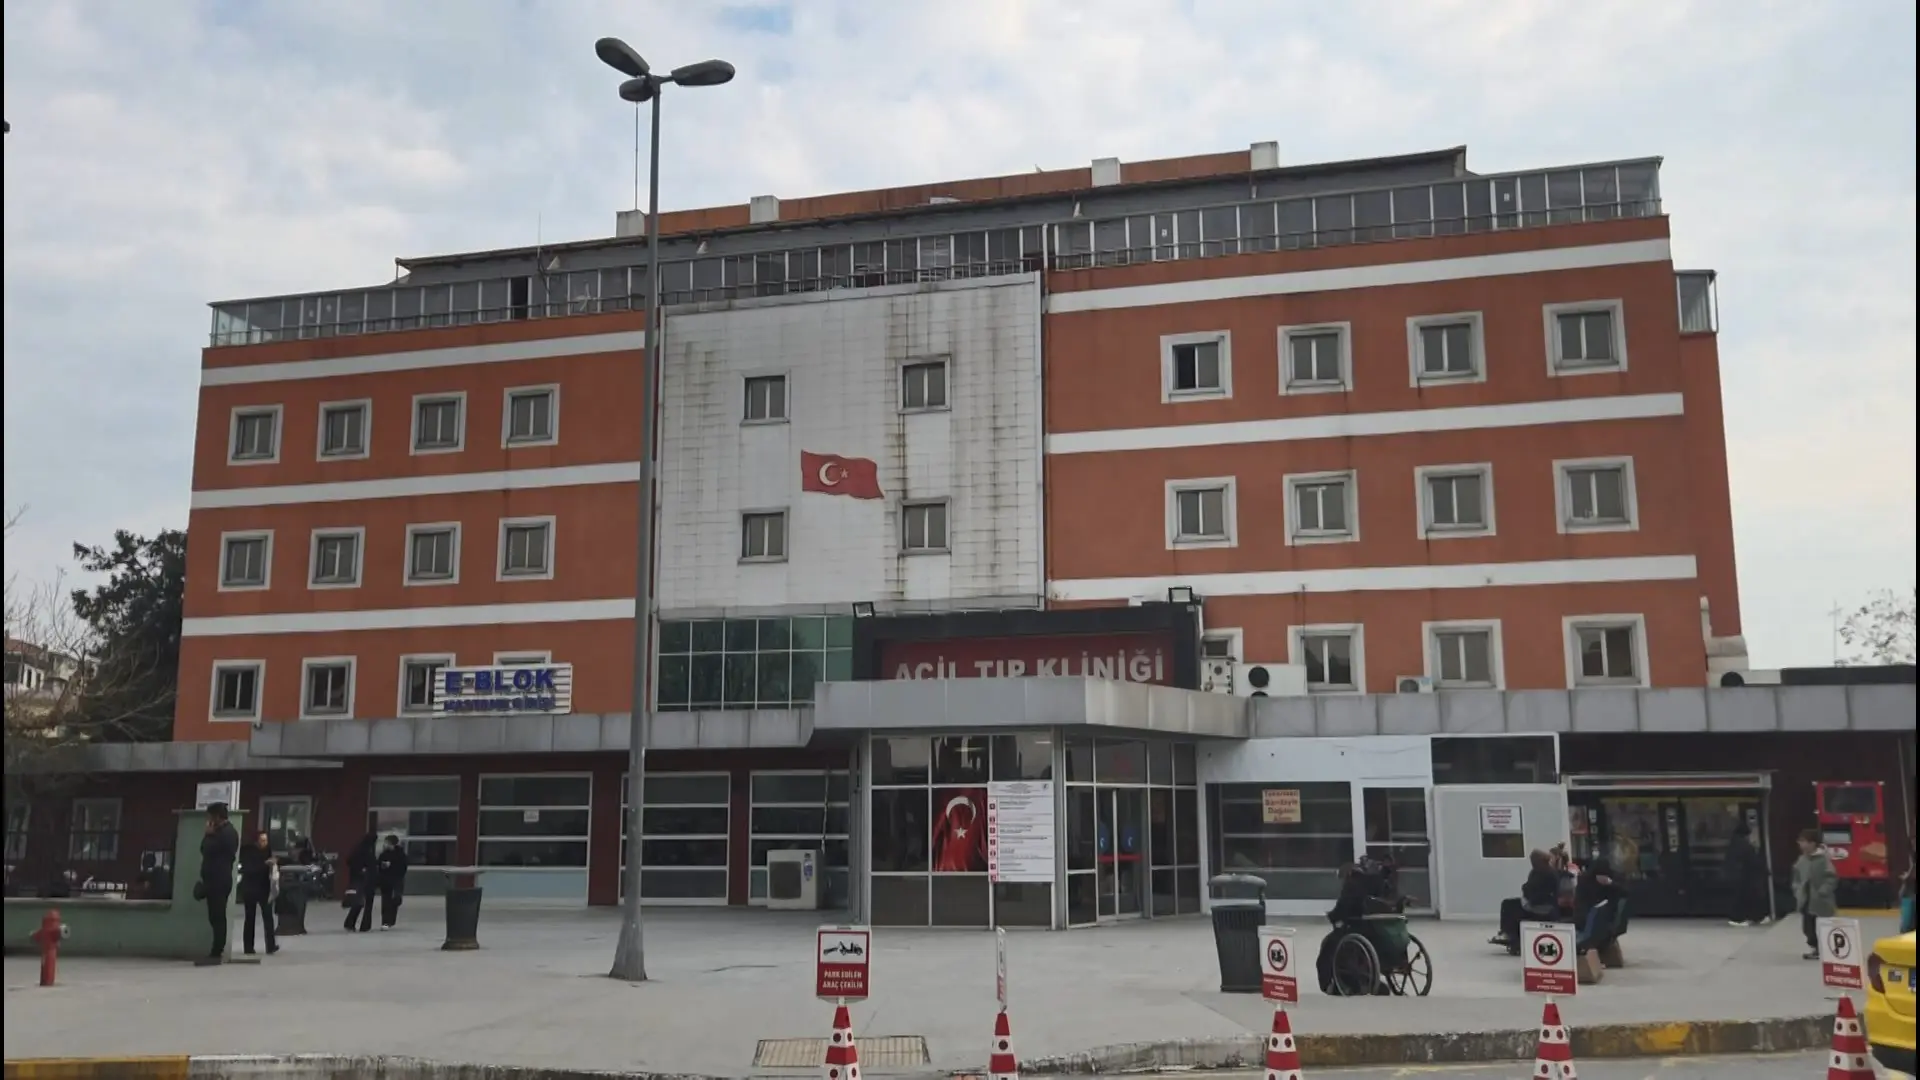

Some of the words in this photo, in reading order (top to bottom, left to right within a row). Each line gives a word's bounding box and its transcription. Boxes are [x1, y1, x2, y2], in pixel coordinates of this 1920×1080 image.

[973, 660, 1027, 679] TIP
[1036, 649, 1163, 682] KLİNİĞİ
[445, 670, 554, 692] E-BLOK
[824, 969, 840, 978] PARK
[841, 968, 862, 978] EDİLEN
[823, 981, 839, 991] ARAÇ
